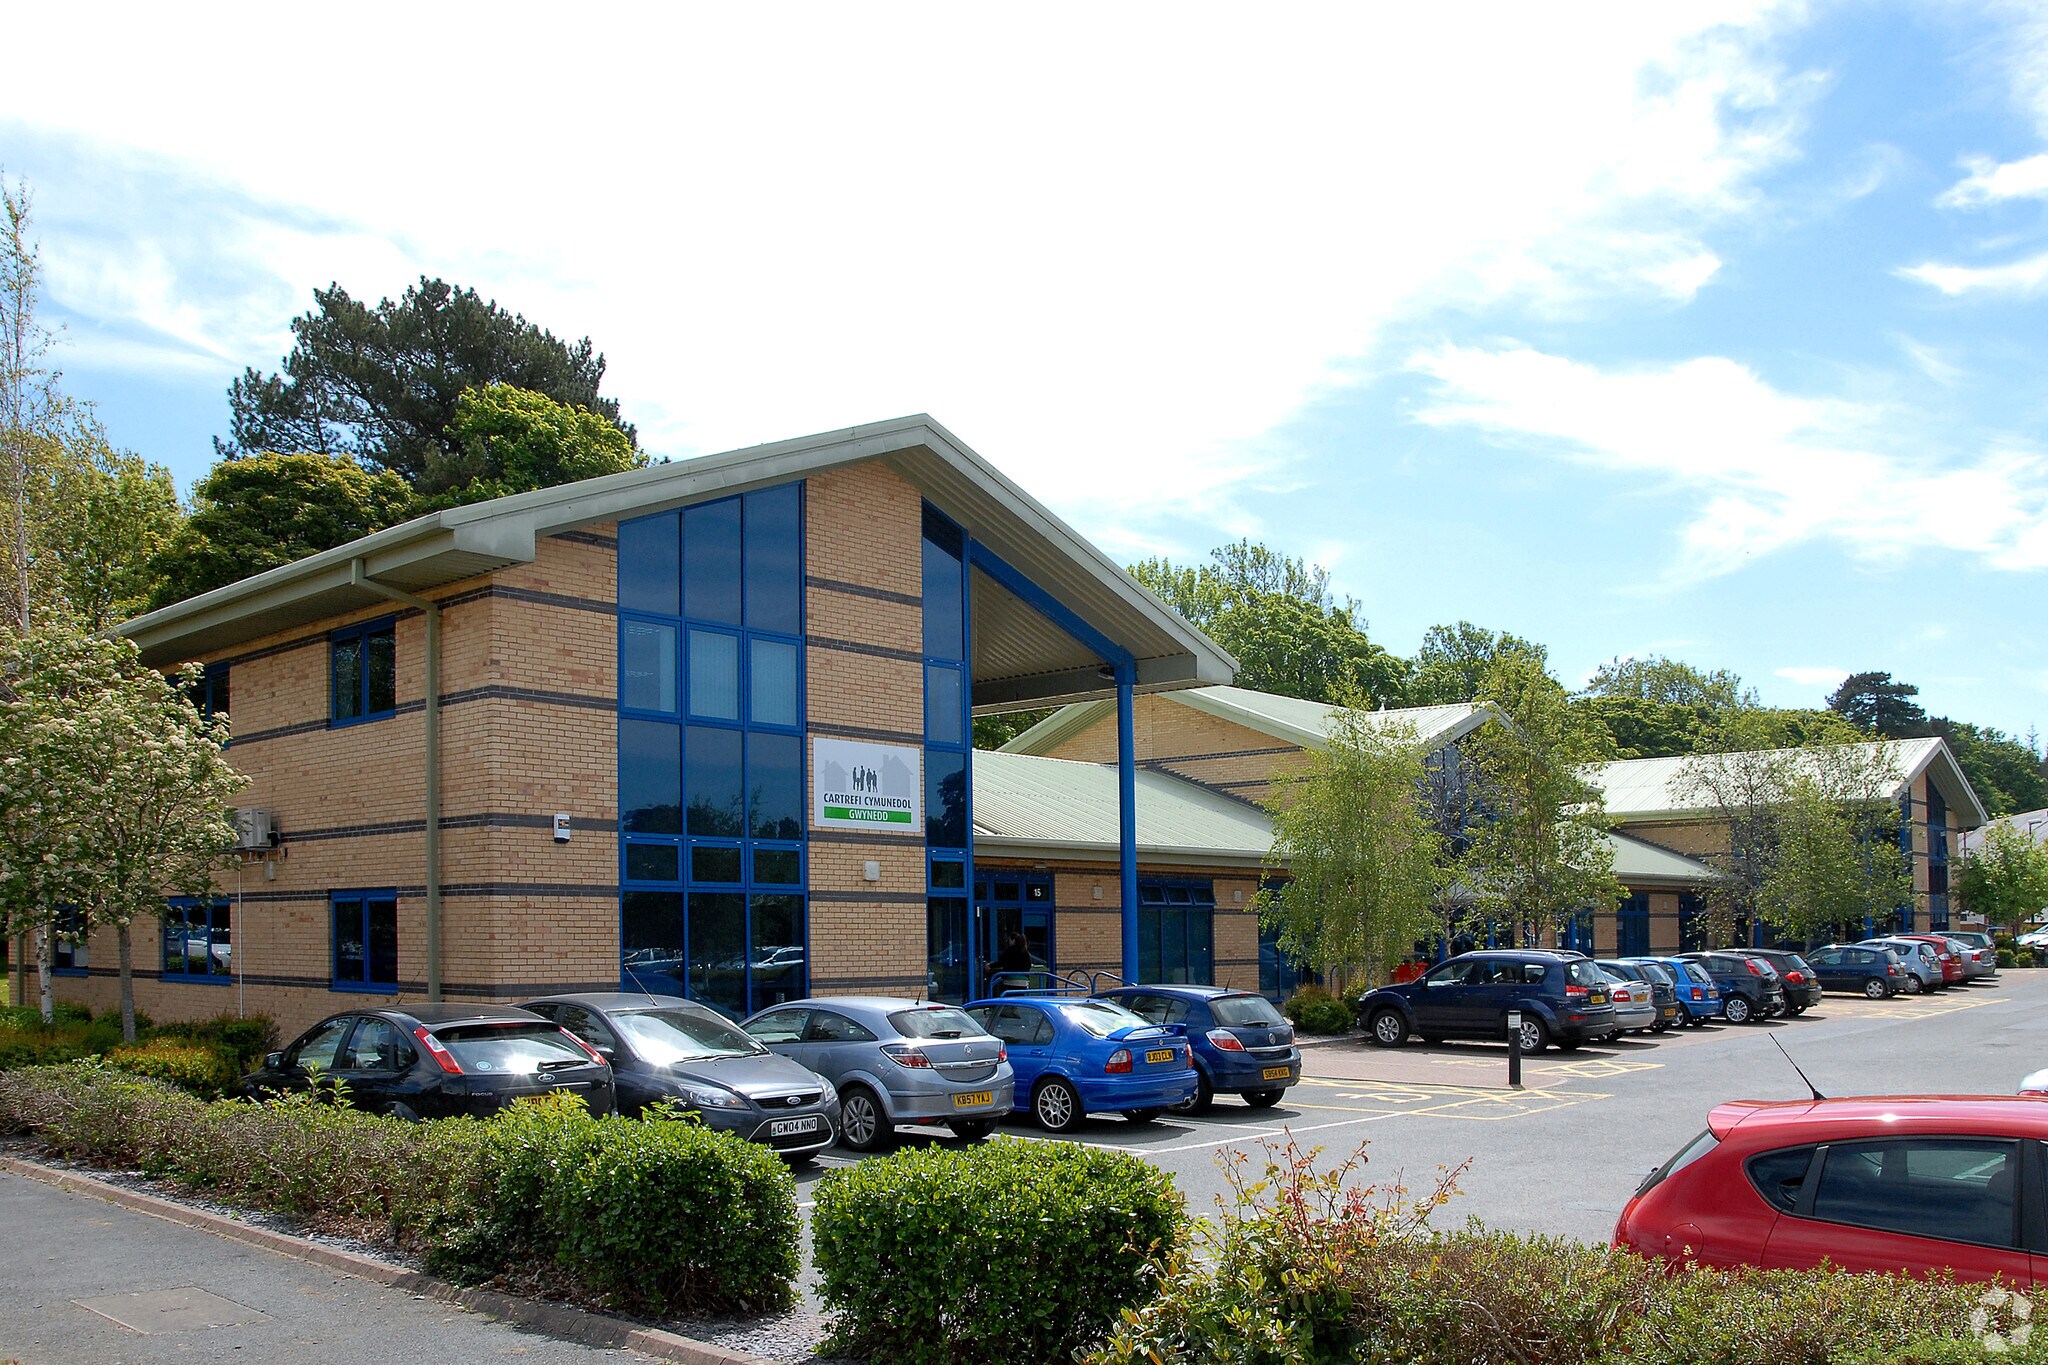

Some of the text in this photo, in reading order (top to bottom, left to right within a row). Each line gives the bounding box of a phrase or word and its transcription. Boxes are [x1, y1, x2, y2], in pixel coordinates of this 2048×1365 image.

[823, 793, 912, 809] CARTREFI CYMUNEDOL
[848, 809, 888, 821] GWYNEDD
[1034, 888, 1042, 897] 15
[956, 1092, 991, 1105] KB57 YAJ
[801, 1118, 816, 1131] NNO
